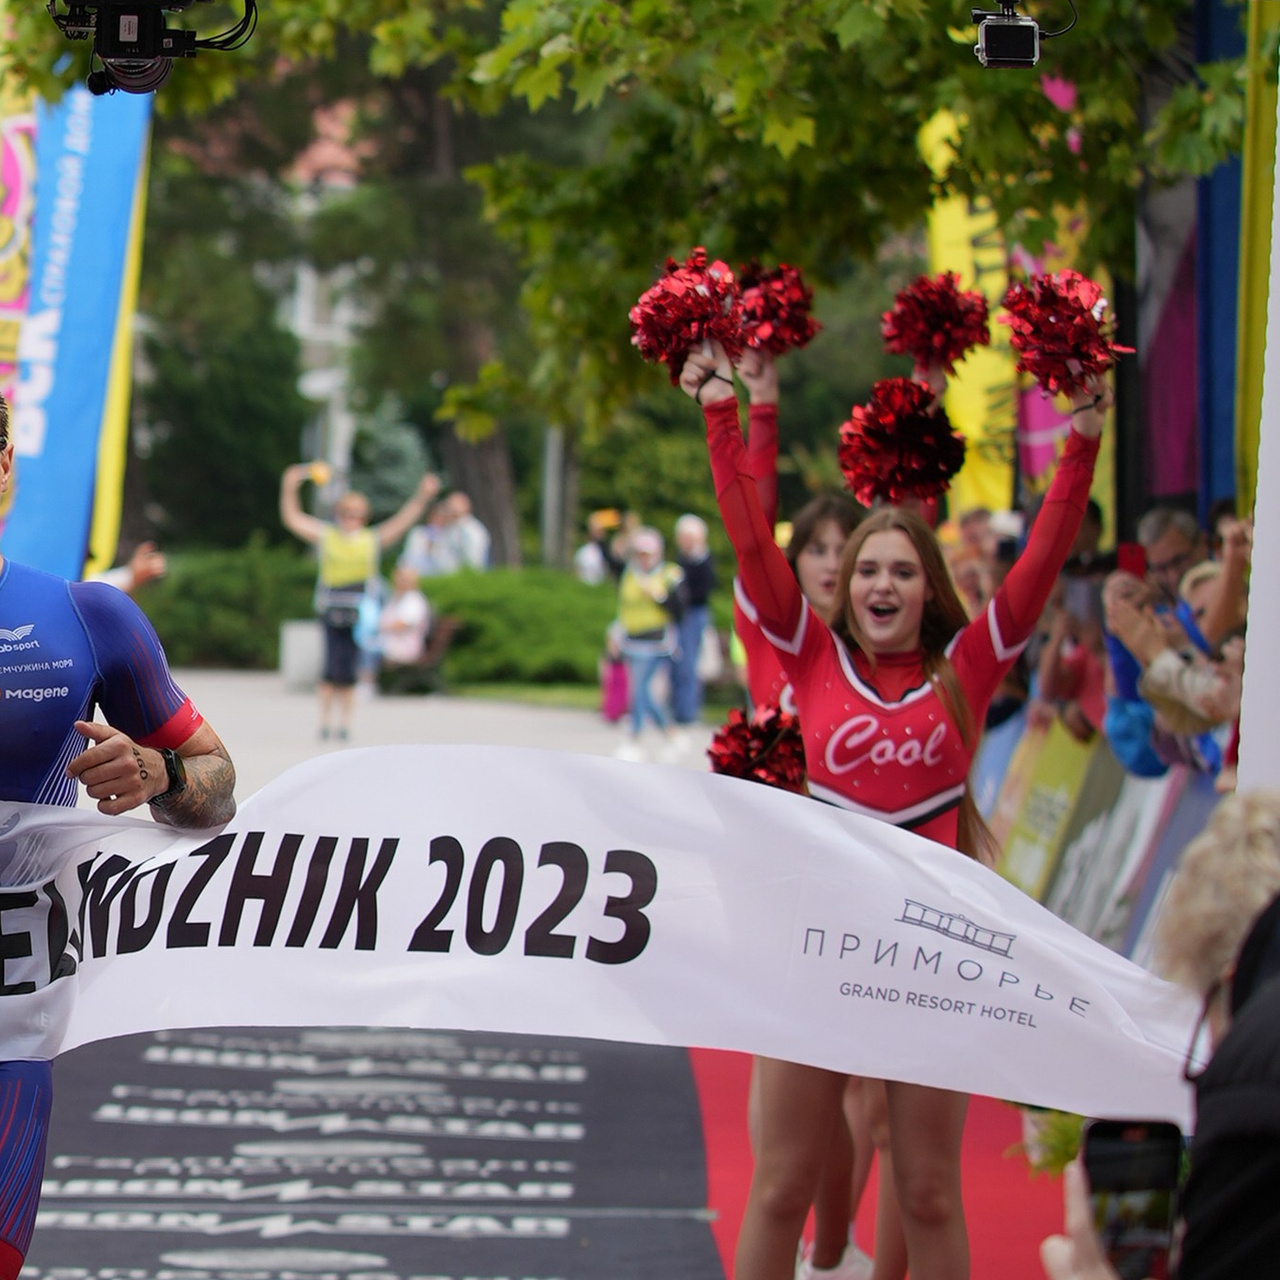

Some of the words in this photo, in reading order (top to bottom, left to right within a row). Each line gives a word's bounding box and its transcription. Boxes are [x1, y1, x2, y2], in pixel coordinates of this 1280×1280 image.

[5, 686, 69, 702] Magene
[824, 714, 948, 775] Cool
[406, 834, 659, 966] 2023
[803, 927, 1091, 1019] ПРИМОРЬЕ
[839, 981, 901, 1003] GRAND
[904, 990, 977, 1017] RESORT
[980, 1004, 1038, 1029] HOTEL
